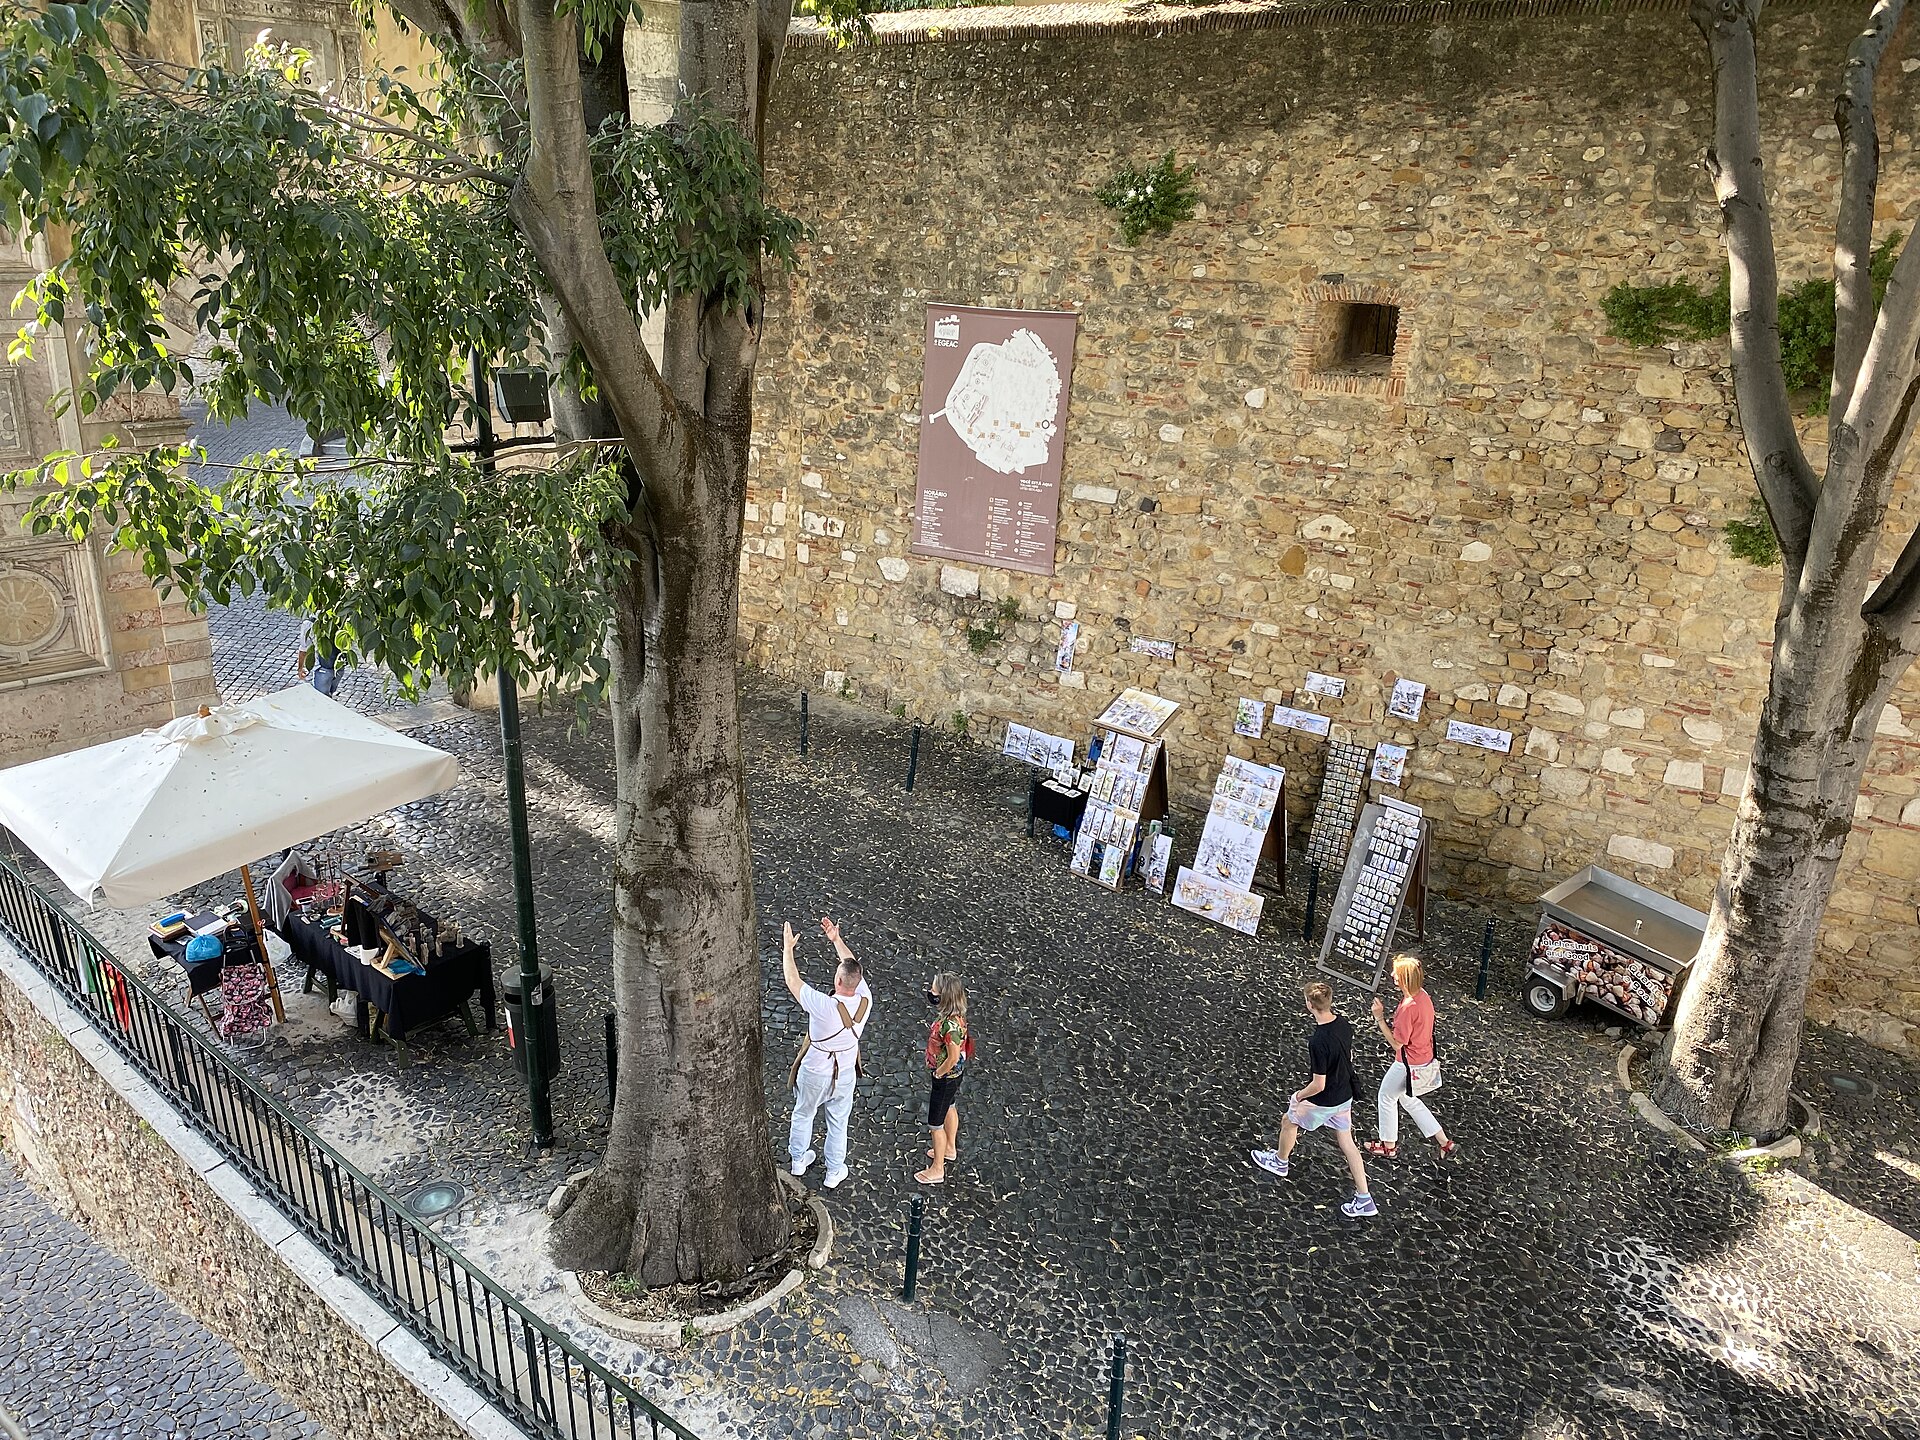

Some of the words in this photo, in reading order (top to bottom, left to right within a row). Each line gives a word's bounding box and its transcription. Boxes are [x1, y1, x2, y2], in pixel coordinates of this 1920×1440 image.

[938, 339, 959, 348] EGEAC
[1553, 940, 1599, 952] chestnuts
[1545, 949, 1564, 959] and
[1564, 950, 1590, 961] Good
